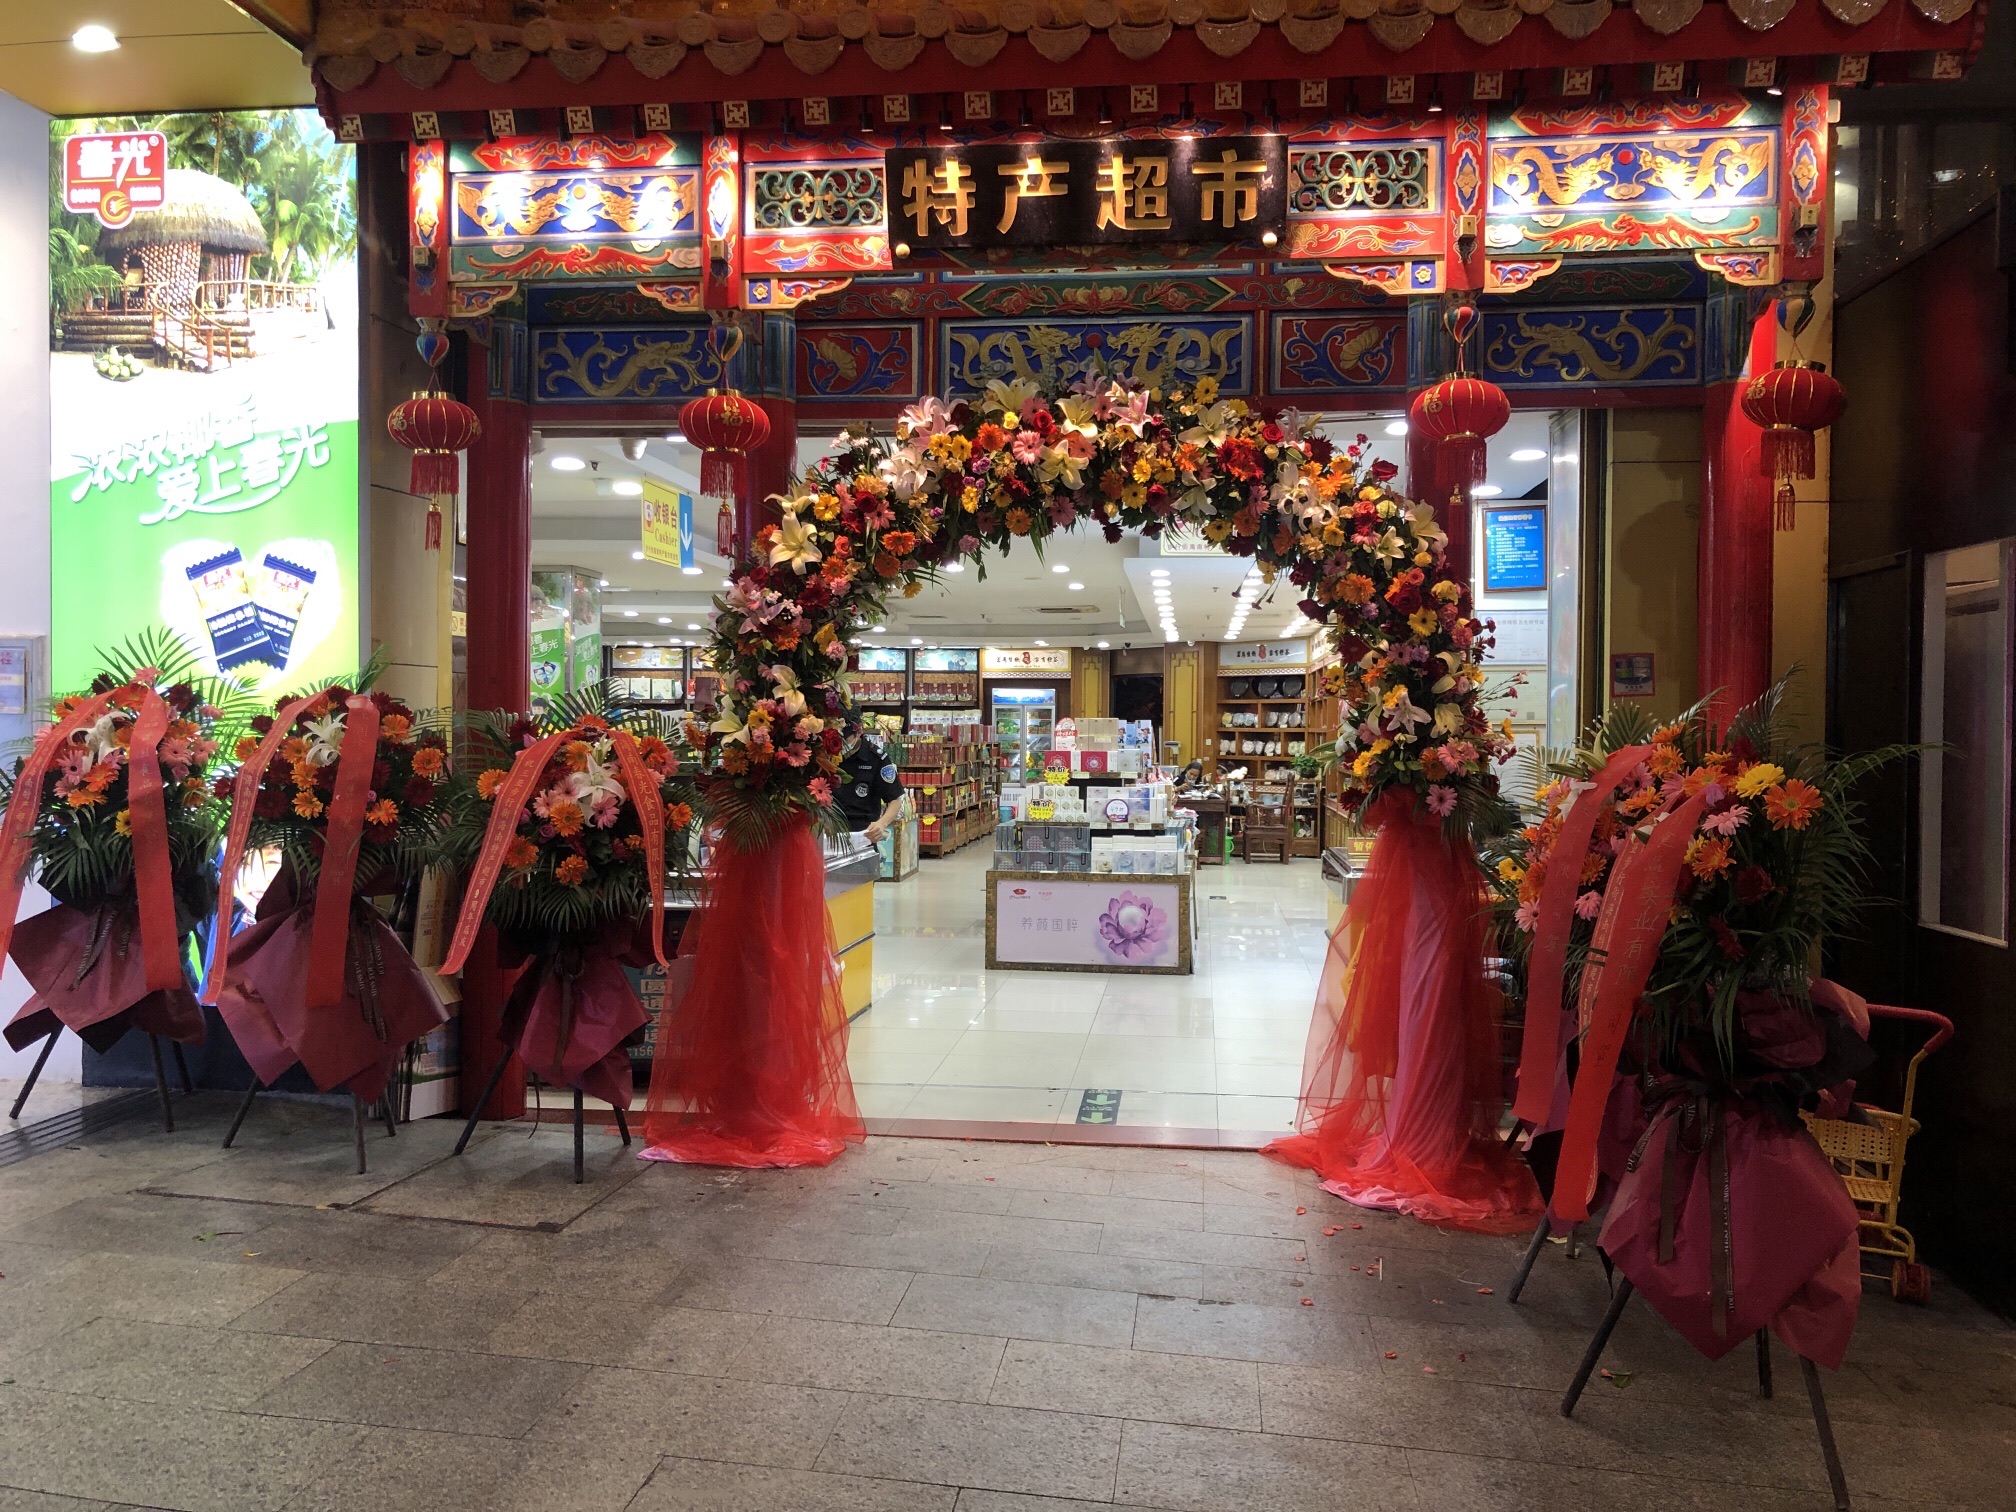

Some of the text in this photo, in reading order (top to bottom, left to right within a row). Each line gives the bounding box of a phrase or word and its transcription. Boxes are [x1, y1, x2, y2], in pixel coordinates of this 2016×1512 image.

[901, 149, 1268, 237] 特产超市
[139, 421, 331, 526] 爱上春光
[654, 498, 678, 530] 收银台
[654, 528, 678, 548] Cashier
